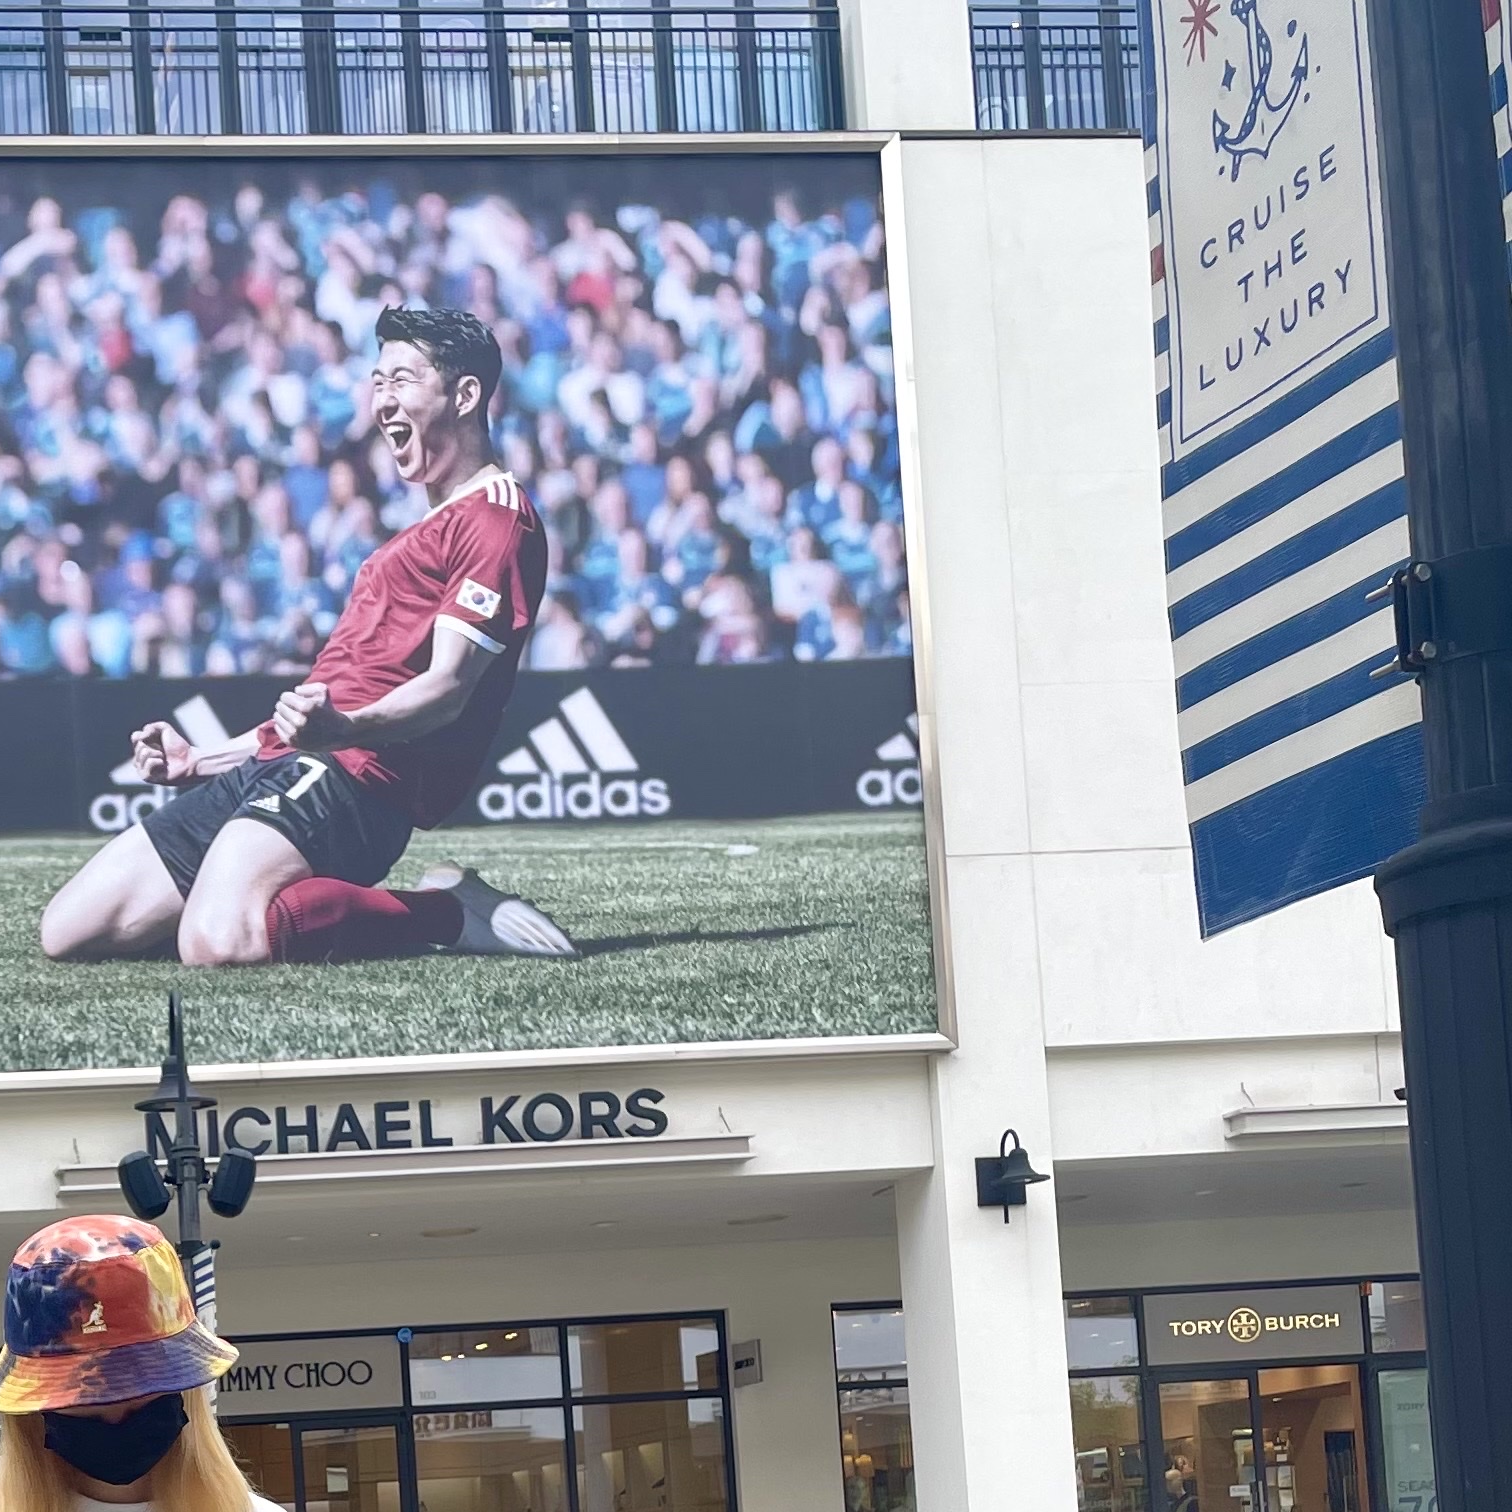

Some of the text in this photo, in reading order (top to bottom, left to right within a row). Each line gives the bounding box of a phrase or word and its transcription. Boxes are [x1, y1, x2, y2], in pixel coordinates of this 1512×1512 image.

[1199, 144, 1337, 269] CRUISE
[1237, 229, 1308, 303] THE
[1199, 259, 1353, 391] LUXURY
[286, 756, 328, 801] 7
[478, 770, 672, 821] adidas
[144, 1088, 670, 1159] MICHAEL KORS
[1168, 1313, 1340, 1337] TORY BURCH
[219, 1360, 373, 1392] IMMY CHOO
